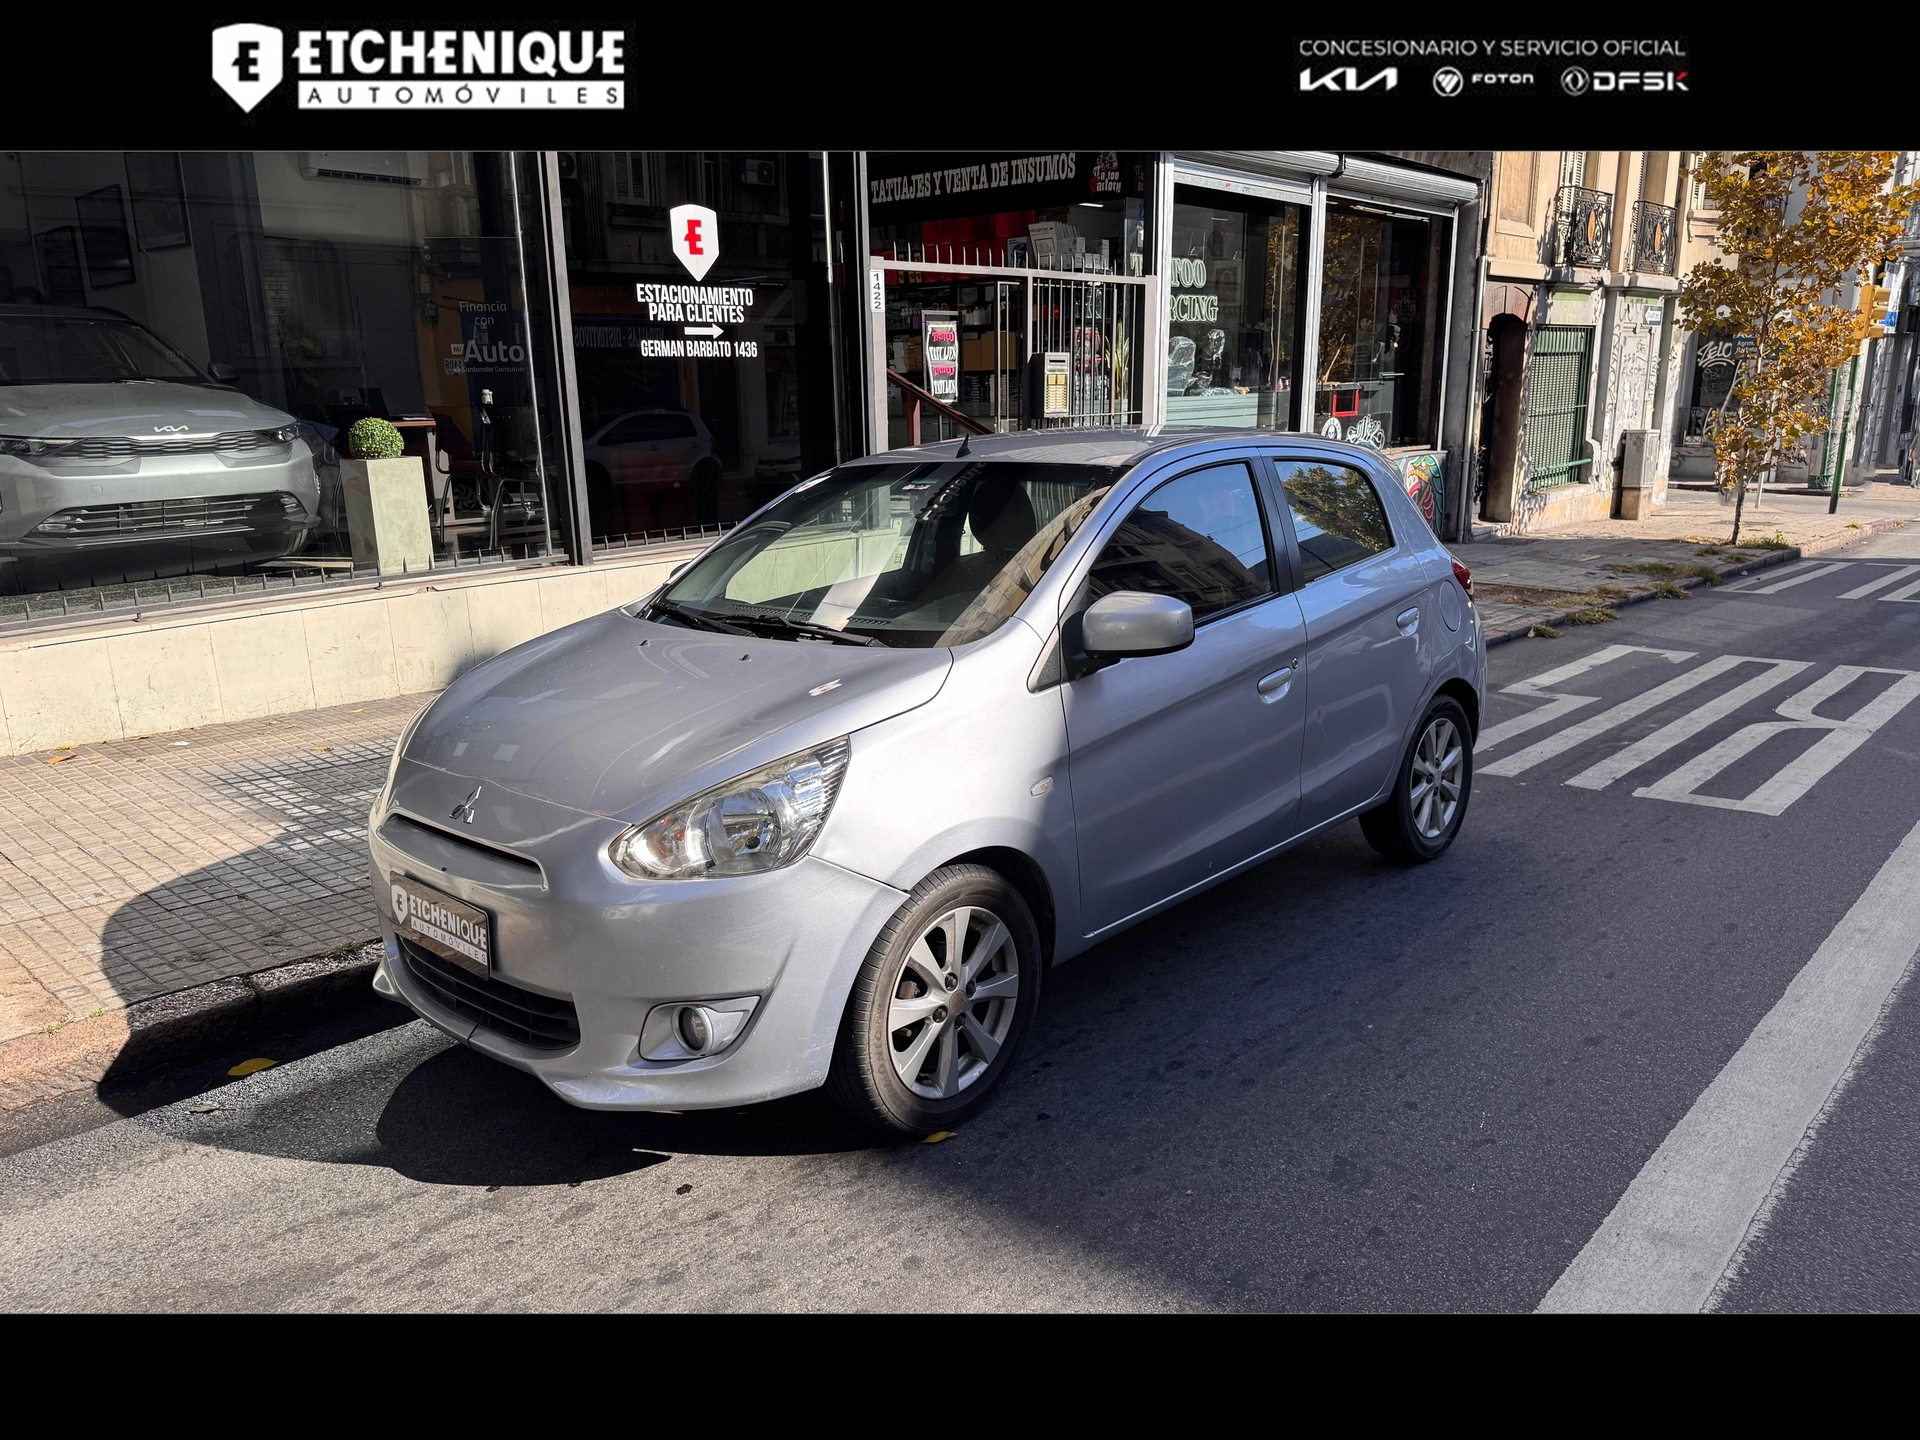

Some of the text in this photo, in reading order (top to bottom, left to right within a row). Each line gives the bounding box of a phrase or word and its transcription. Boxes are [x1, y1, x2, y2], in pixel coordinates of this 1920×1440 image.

[871, 152, 1076, 203] TATUAJES Y VENTA DE INSUMOS
[636, 283, 753, 306] ESTACIONAMIENTO
[873, 273, 881, 309] 1422
[460, 301, 507, 312] Financia
[648, 303, 745, 323] PARA CLIENTES
[474, 316, 494, 325] con
[464, 340, 525, 363] Auto
[640, 339, 758, 358] GERMAN BARBATO 1436
[409, 894, 488, 950] ETCHENIQUE
